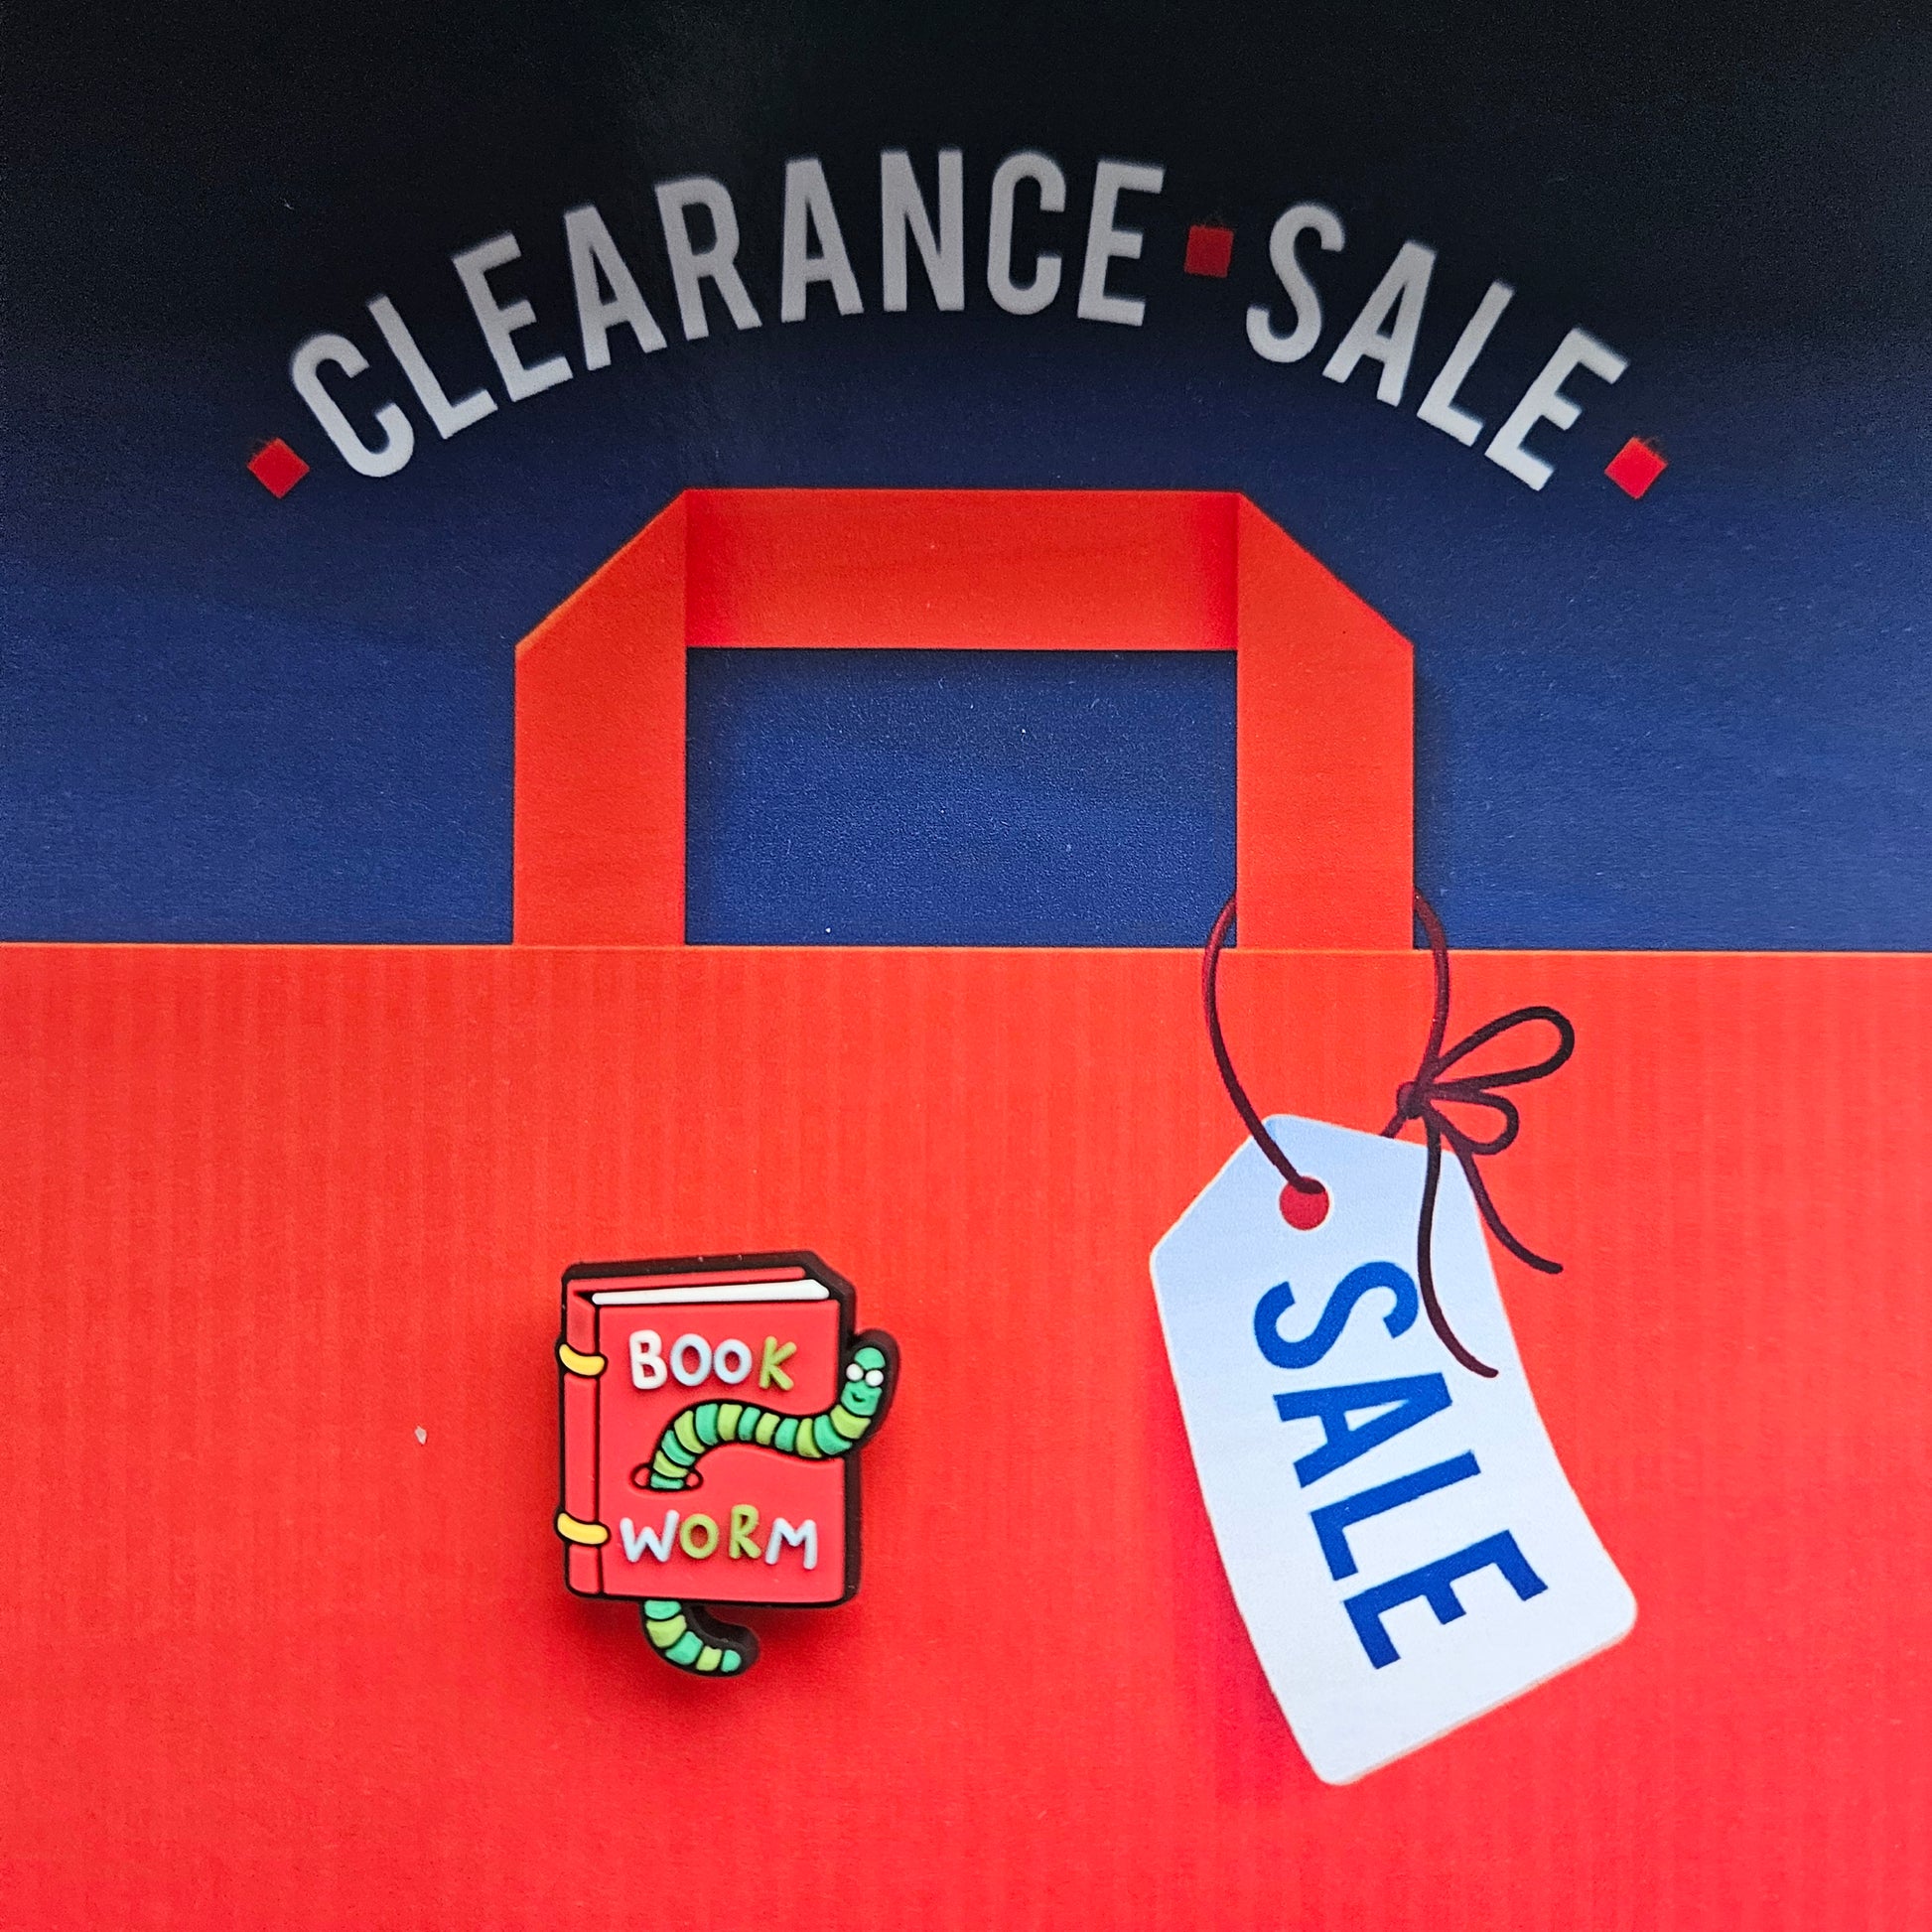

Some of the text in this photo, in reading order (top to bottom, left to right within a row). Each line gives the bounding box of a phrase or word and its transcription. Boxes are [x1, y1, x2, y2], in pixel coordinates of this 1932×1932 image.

[289, 149, 1629, 492] CLEARANCE SALE
[627, 1328, 798, 1391] BOOK
[619, 1503, 819, 1571] WORM
[1252, 1260, 1550, 1671] SALE
